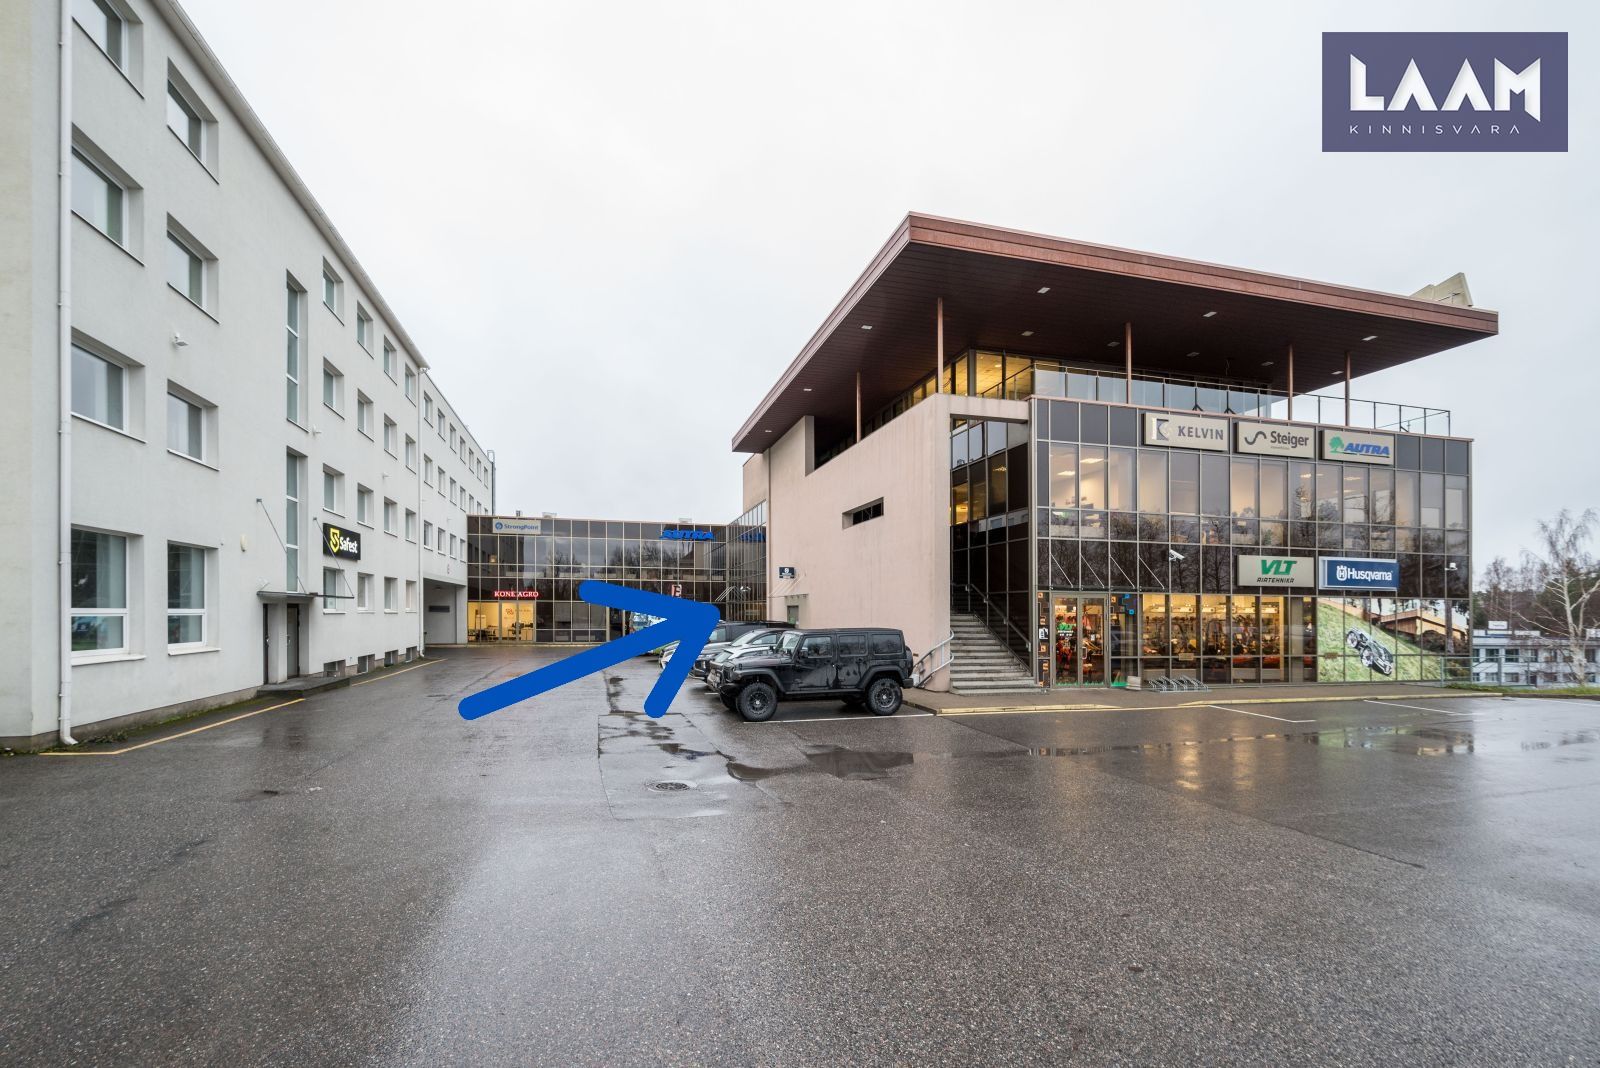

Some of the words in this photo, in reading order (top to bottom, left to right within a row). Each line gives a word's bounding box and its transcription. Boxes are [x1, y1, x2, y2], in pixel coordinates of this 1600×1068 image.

[1178, 426, 1224, 441] KELVIN
[1270, 430, 1309, 449] Steiger
[1344, 442, 1390, 455] AUTRA
[339, 536, 358, 554] Safest
[1261, 559, 1297, 576] VLT
[1347, 567, 1393, 582] Husqvarna
